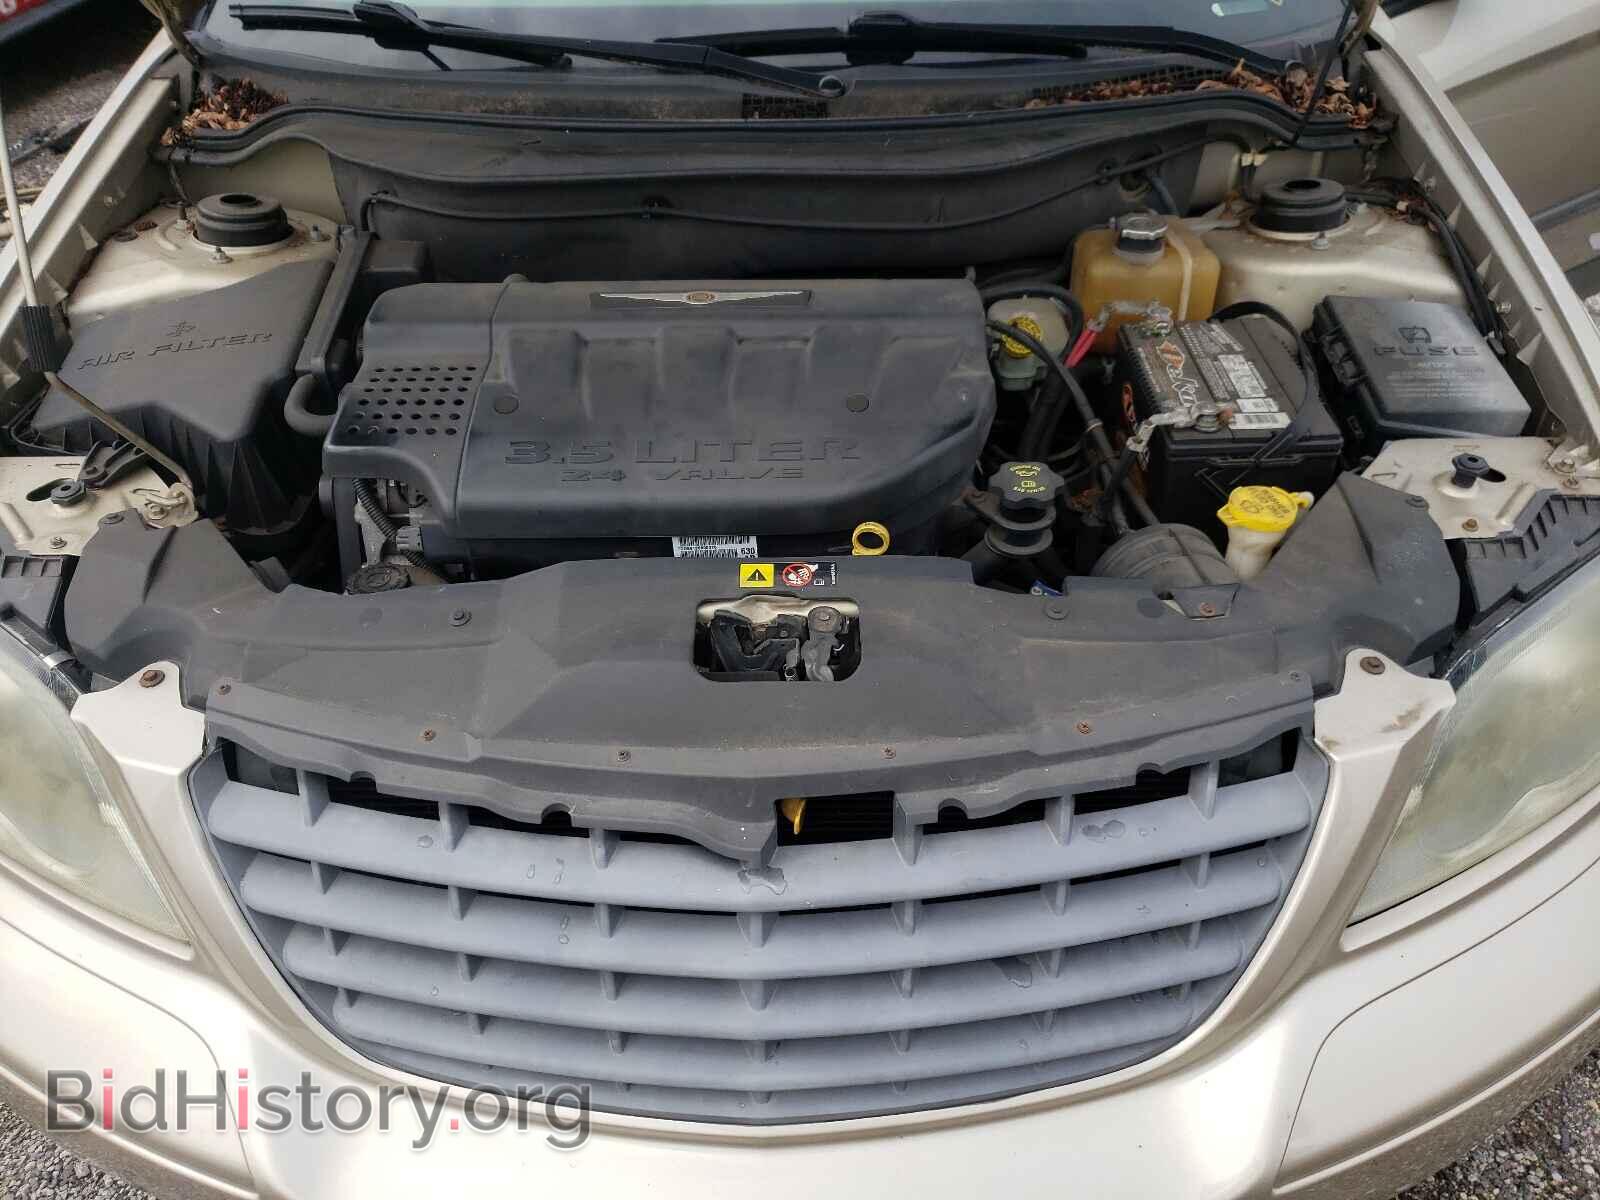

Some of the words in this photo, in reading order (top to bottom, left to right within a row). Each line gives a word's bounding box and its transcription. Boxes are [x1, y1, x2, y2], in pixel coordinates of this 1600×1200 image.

[78, 351, 136, 370] AIR
[148, 333, 272, 356] FILTER
[1374, 346, 1479, 356] FUSE
[504, 440, 614, 464] 3.5
[634, 440, 861, 464] LITER
[655, 468, 802, 480] VALVE
